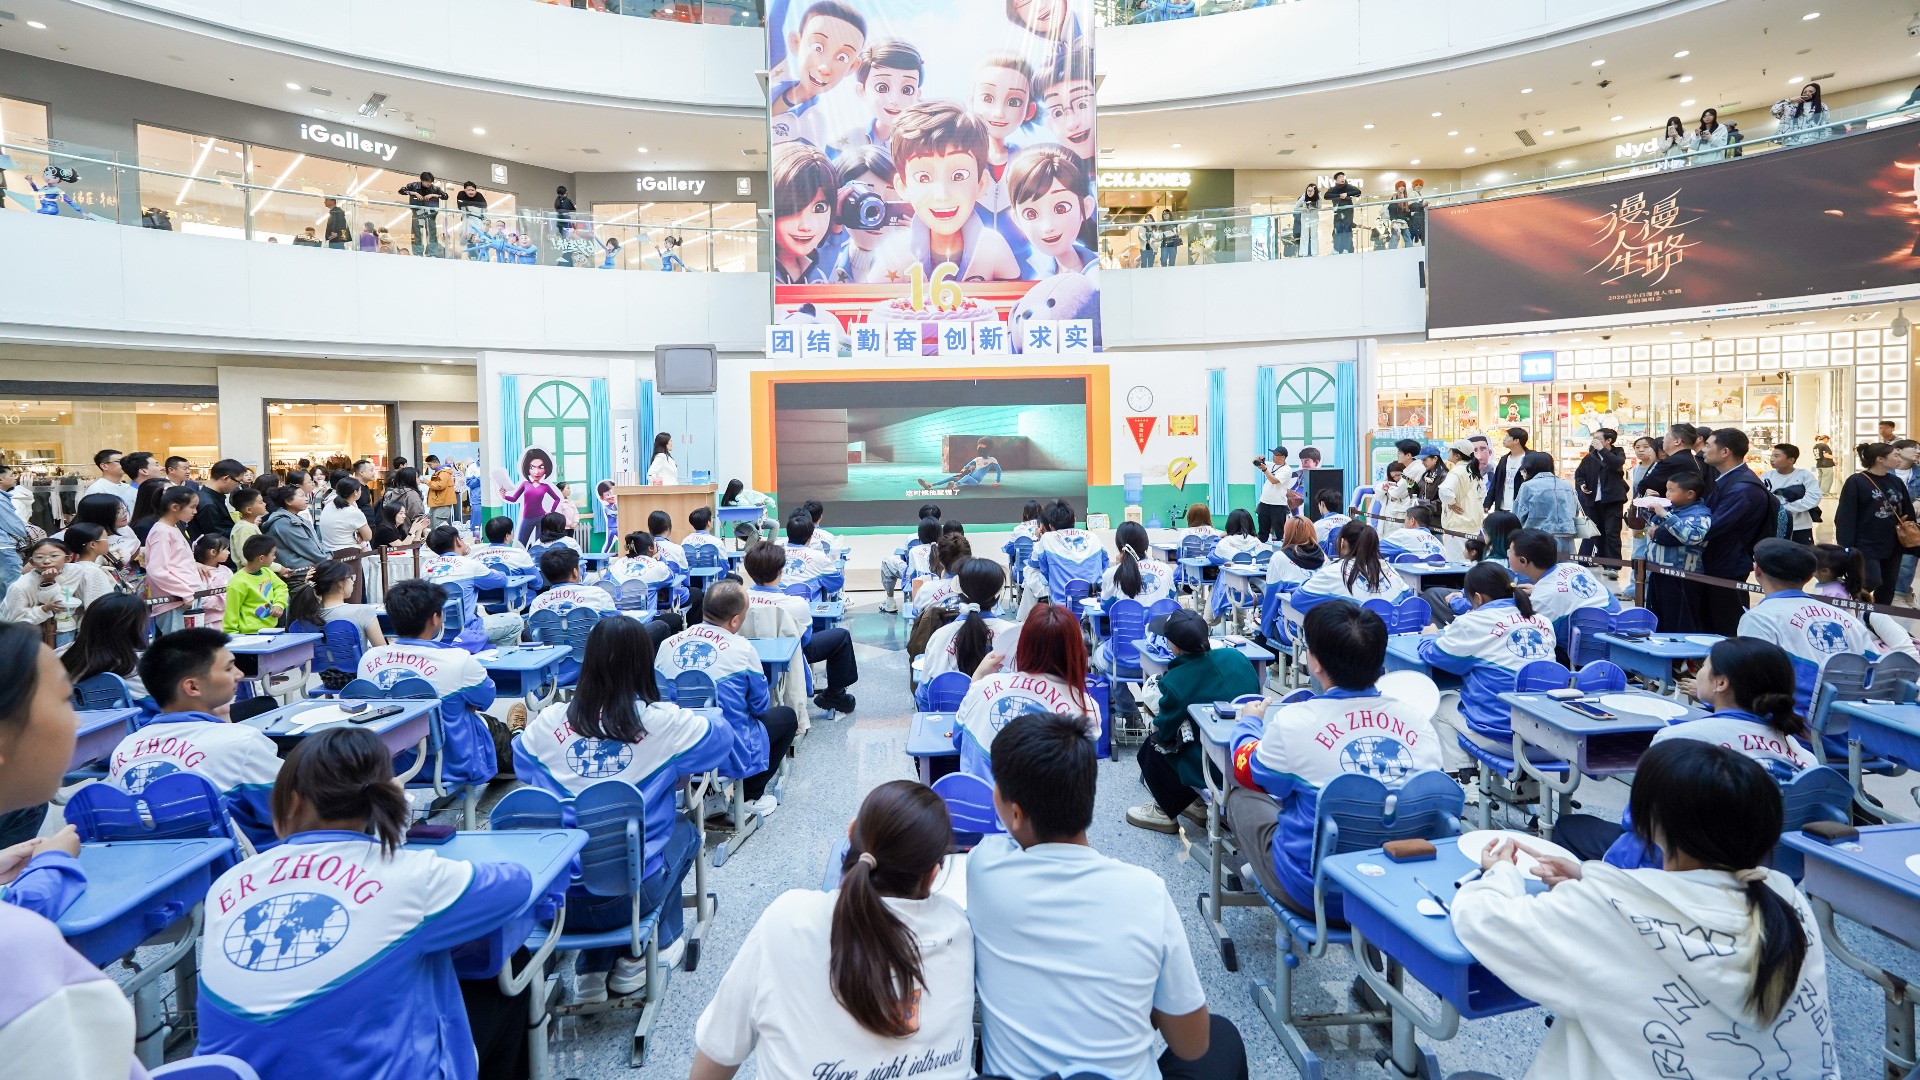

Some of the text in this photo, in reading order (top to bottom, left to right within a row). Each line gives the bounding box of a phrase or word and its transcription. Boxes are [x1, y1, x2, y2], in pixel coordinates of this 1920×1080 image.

[301, 123, 398, 162] iGallery
[1615, 138, 1660, 158] Nyd
[636, 176, 706, 195] iGallery
[1582, 188, 1702, 247] 漫漫
[1583, 229, 1702, 287] 人生路
[903, 260, 964, 312] 16
[771, 324, 1088, 353] 团结 勤奋 创新 求实
[549, 589, 587, 604] ZHONG
[932, 588, 946, 601] ER
[1735, 582, 1765, 593] 红旗街万
[1790, 605, 1853, 630] ER ZHONG
[1831, 598, 1875, 612] 红旗街万达
[668, 626, 730, 651] ER ZHONG
[1490, 621, 1510, 638] ER
[366, 651, 438, 677] ER ZHONG
[982, 675, 1071, 715] ER ZHONG
[553, 720, 577, 745] ER
[1314, 709, 1419, 751] ER ZHONG
[111, 737, 207, 778] ER ZHONG
[218, 854, 384, 916] ER ZHONG
[812, 1059, 859, 1080] Hope
[864, 1054, 908, 1080] sight
